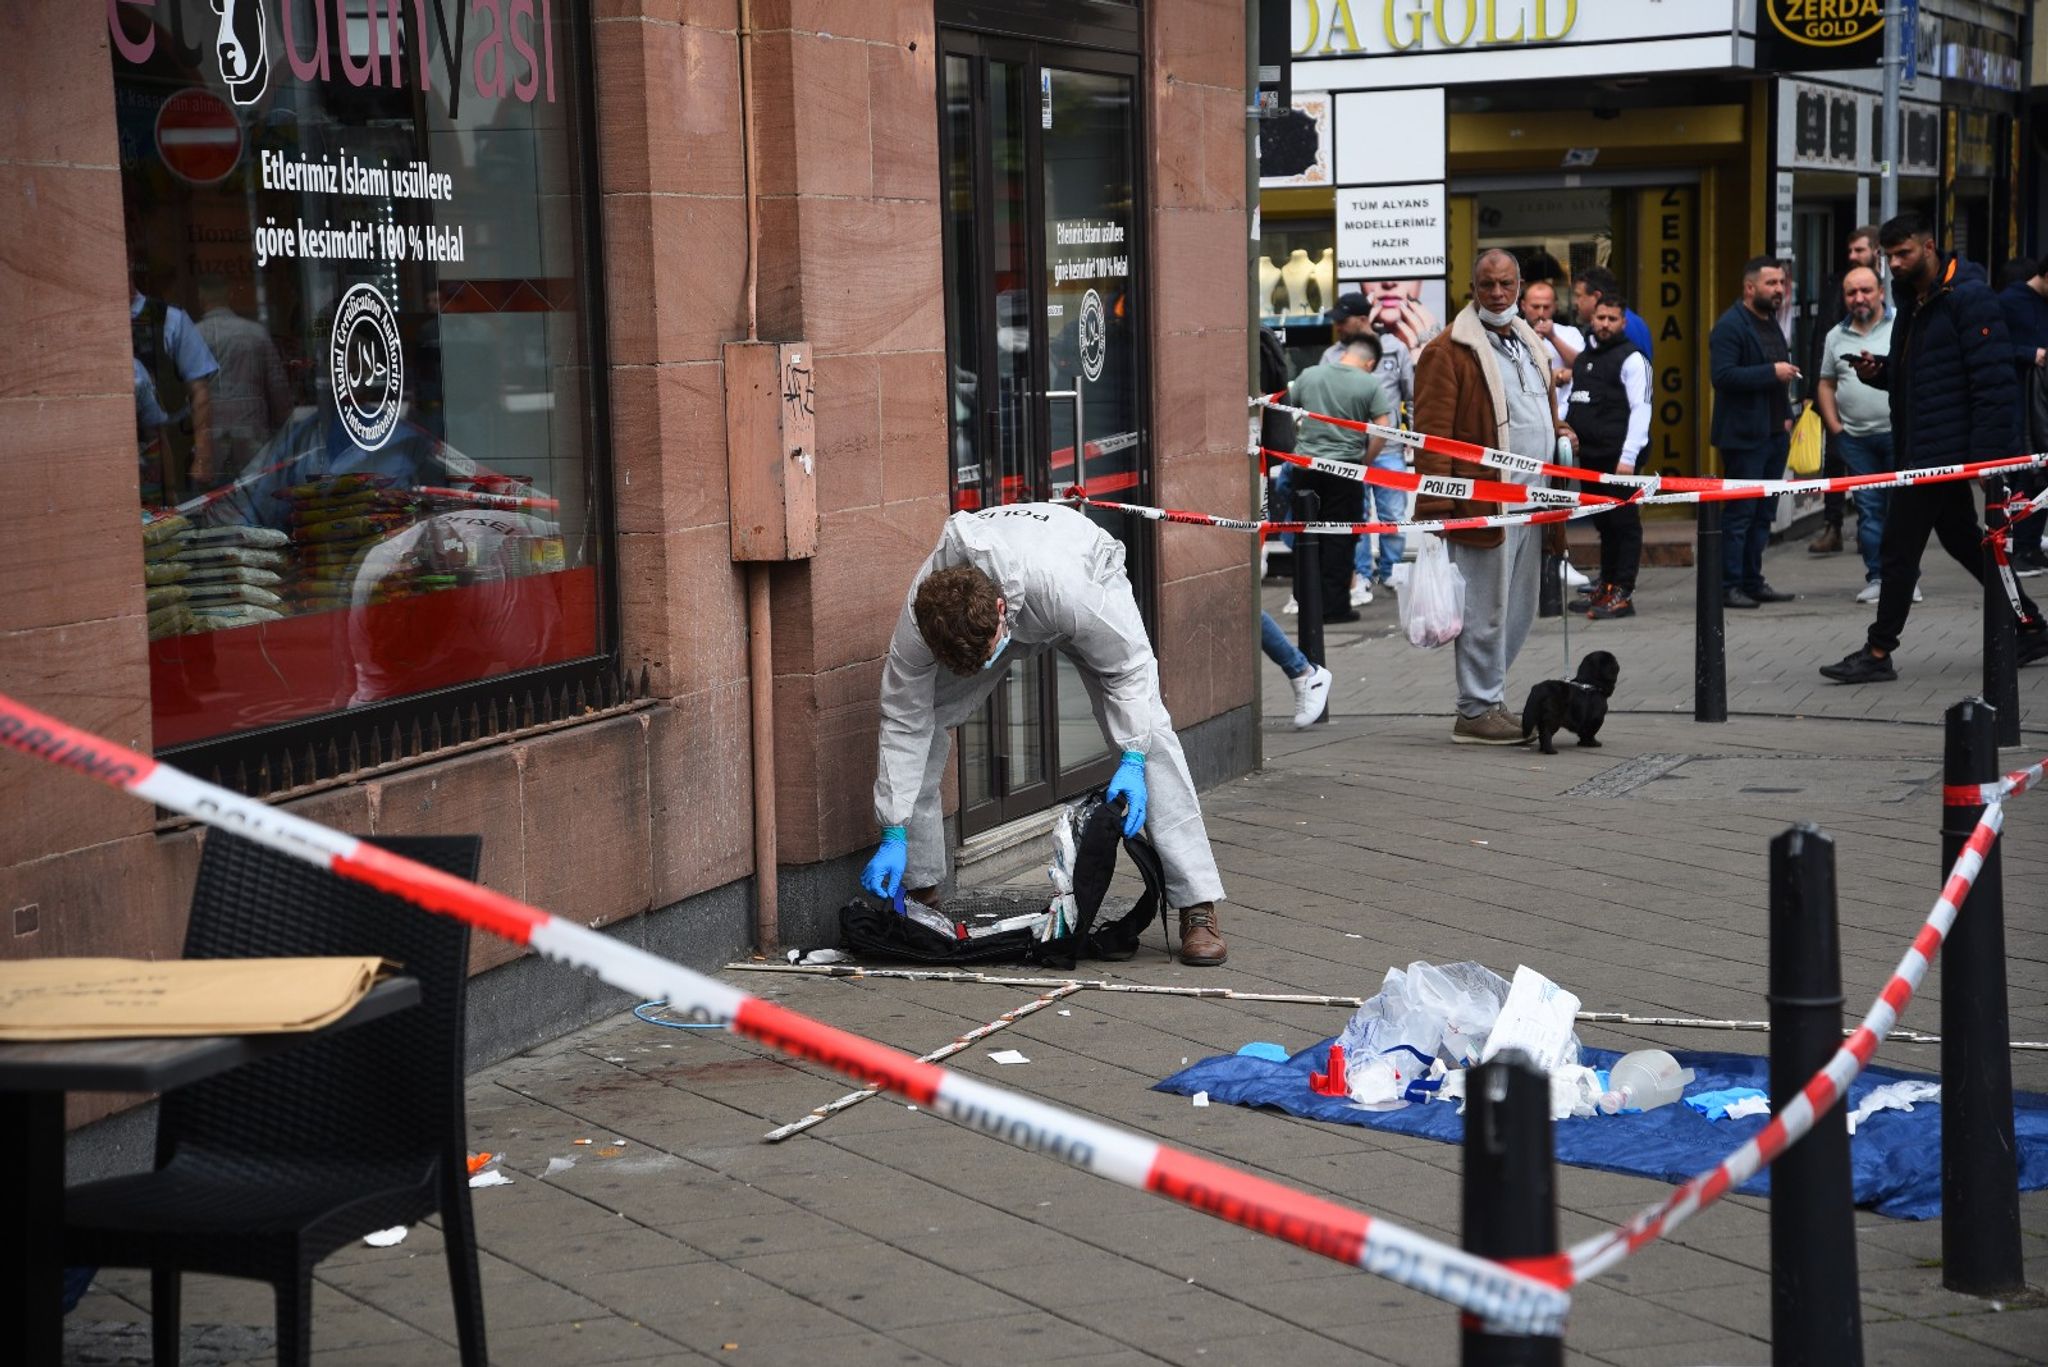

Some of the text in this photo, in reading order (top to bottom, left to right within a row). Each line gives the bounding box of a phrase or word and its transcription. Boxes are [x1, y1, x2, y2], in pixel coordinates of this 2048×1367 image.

[1785, 0, 1880, 22] ZERDA
[1383, 0, 1577, 50] GOLD
[1805, 19, 1859, 39] GOLD
[261, 147, 452, 201] Etlerimiz İslami usüllere
[1352, 199, 1430, 210] TÜM ALYANS
[1345, 217, 1437, 230] MODELLERİMİZ
[255, 216, 464, 267] göre kesimdir! 100 % Helal
[1372, 238, 1410, 248] HAZIR
[1338, 256, 1445, 268] BULUNMAKTADIR
[1660, 187, 1682, 341] ZERDA
[334, 292, 401, 401] Halal Certification Authority
[350, 340, 387, 388] حلال
[1423, 479, 1467, 497] POLIZEI
